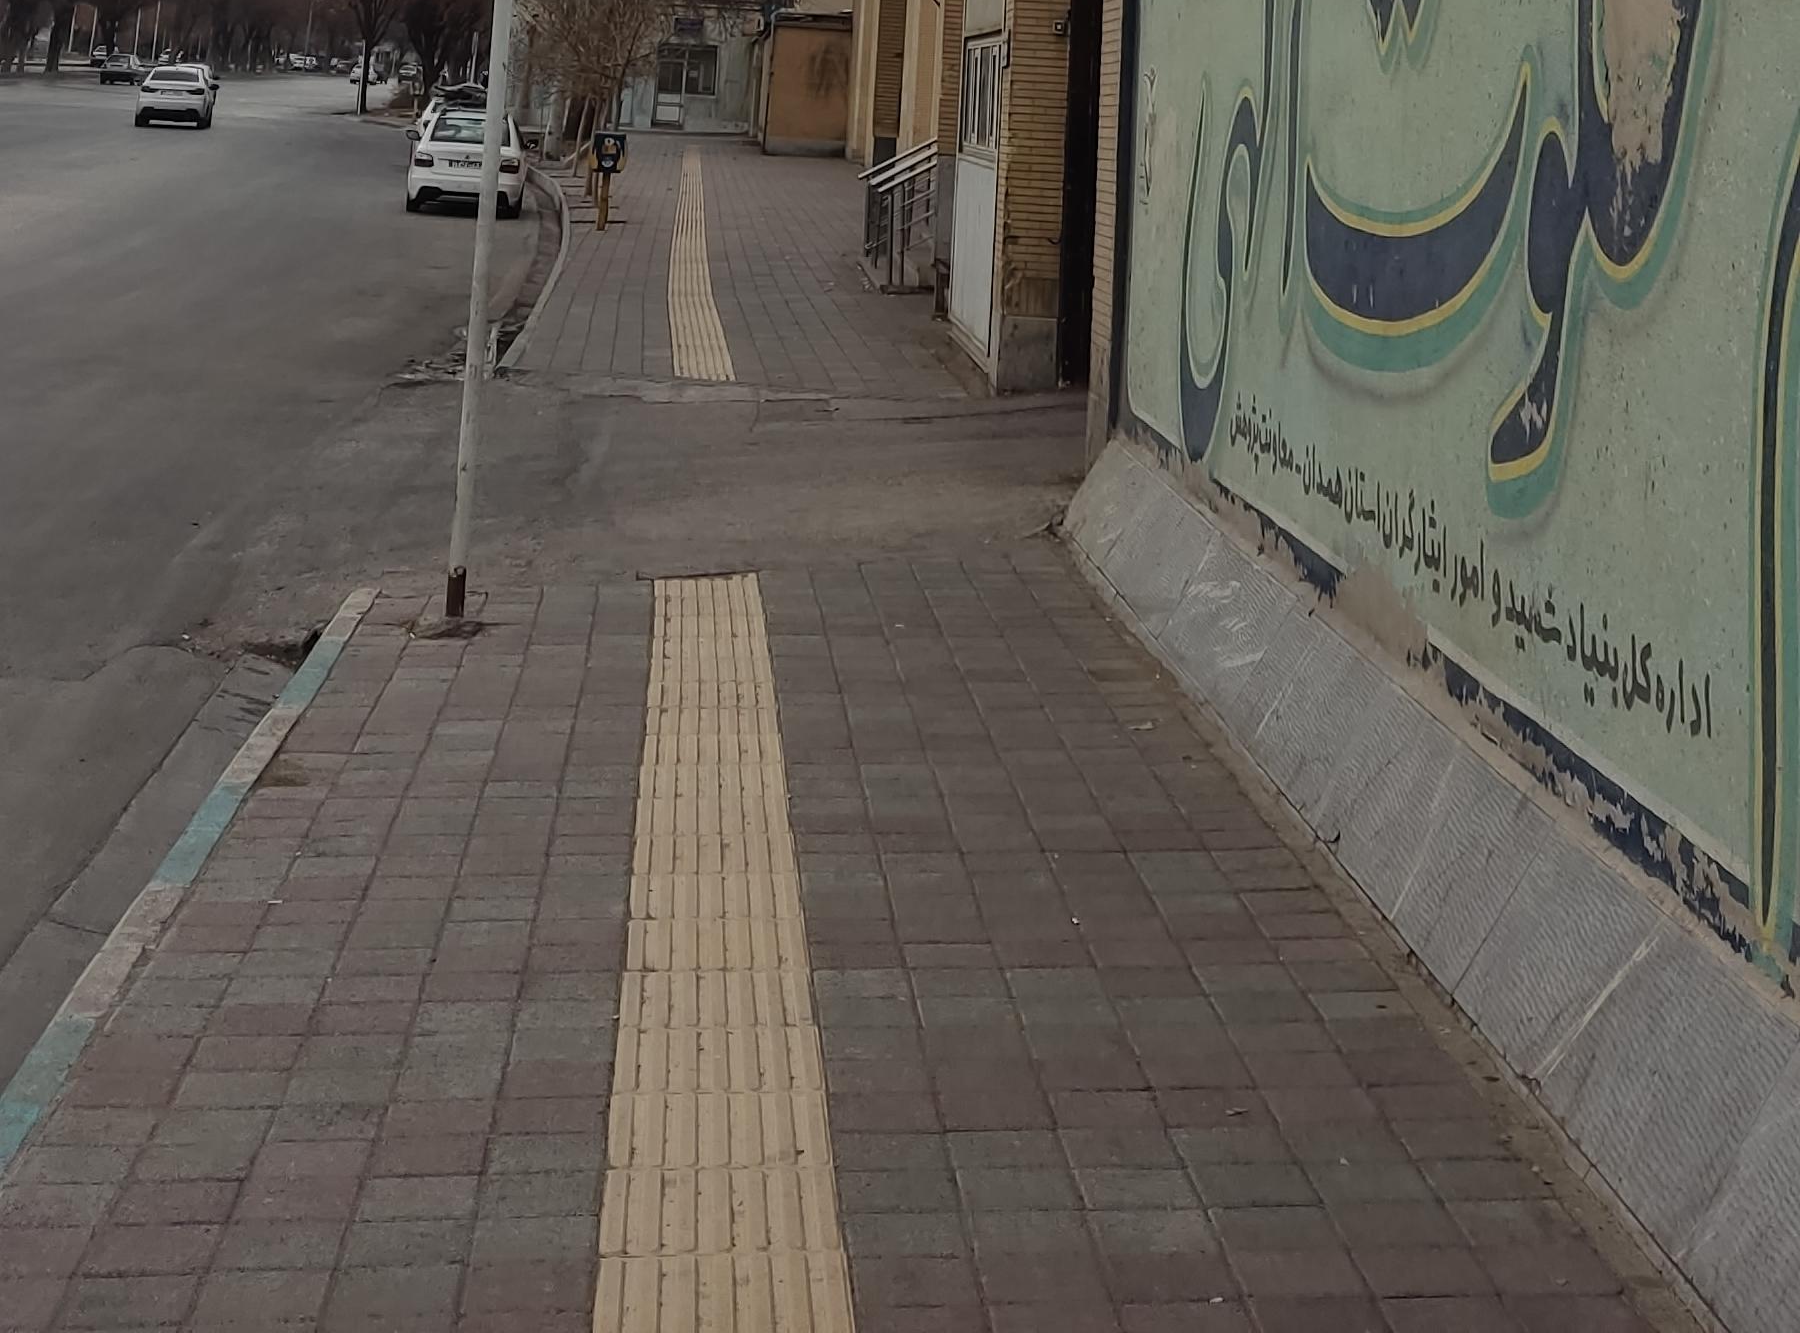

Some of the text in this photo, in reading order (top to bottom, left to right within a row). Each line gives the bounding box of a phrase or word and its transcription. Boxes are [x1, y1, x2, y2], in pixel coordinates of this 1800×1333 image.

[1229, 390, 1259, 475] پژوهش
[1259, 407, 1294, 475] معاونت
[1302, 442, 1343, 510] همدان
[1344, 466, 1381, 533] استان
[1382, 488, 1447, 594] ایثارگران
[1450, 537, 1485, 608] امور
[1491, 568, 1502, 628] و
[1565, 601, 1620, 709] بنیاد
[1622, 632, 1652, 712] کل
[1655, 657, 1712, 739] اداره
